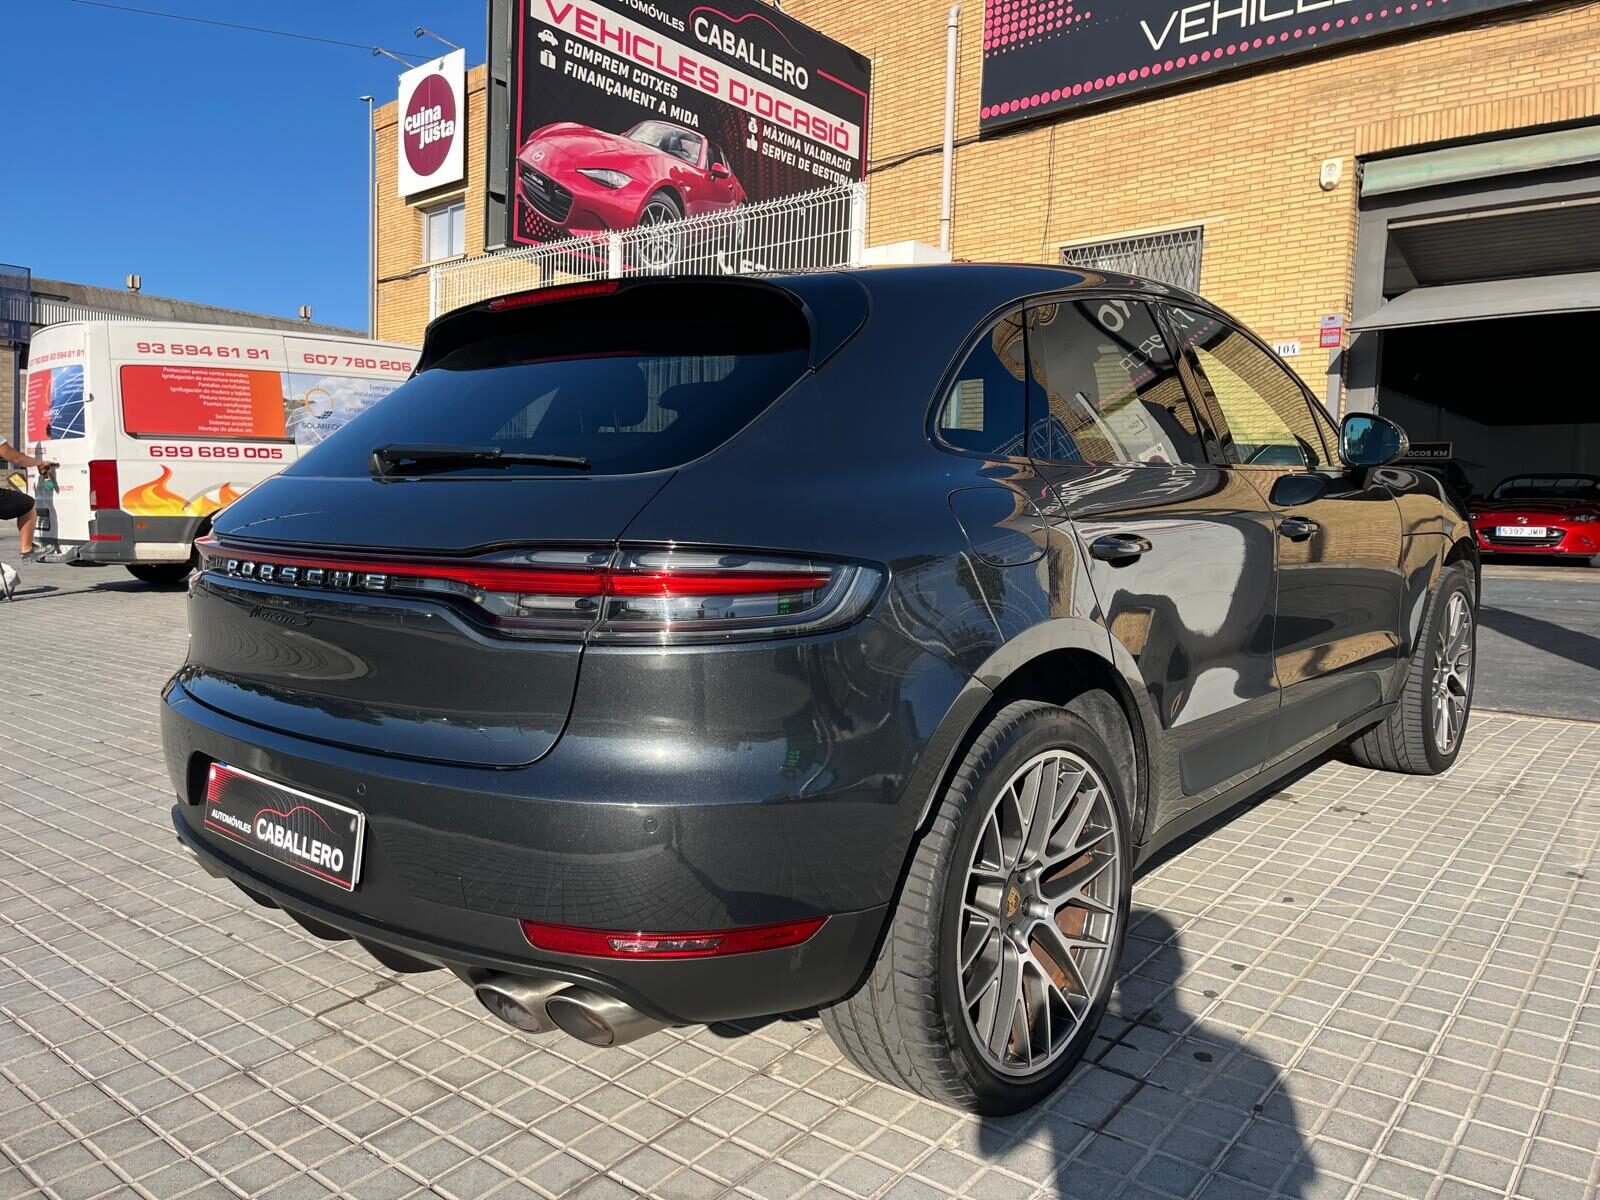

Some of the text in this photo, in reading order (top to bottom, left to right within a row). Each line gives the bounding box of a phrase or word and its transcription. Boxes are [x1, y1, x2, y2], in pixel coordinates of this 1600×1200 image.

[617, 0, 809, 91] TOMÓVILES CABALLERO
[546, 0, 850, 151] VEHICLES D'OCASIÓ
[564, 39, 679, 99] COMPREM COTXES
[564, 61, 699, 128] FINANÇAMENT A MIDA
[405, 105, 442, 132] cuina
[418, 119, 455, 150] justa
[762, 124, 852, 172] MÀXIMA VALORACIÓ
[761, 142, 796, 167] SERVEI
[798, 157, 811, 172] DE
[137, 342, 270, 360] 93 594 61 91
[303, 353, 412, 372] 607 780 206
[1278, 343, 1297, 355] 104
[150, 445, 283, 459] 699 689 005
[1502, 527, 1525, 535] 5397
[227, 559, 388, 590] PORSCHE
[211, 808, 345, 872] AUTOMÓVILES CABALLERO
